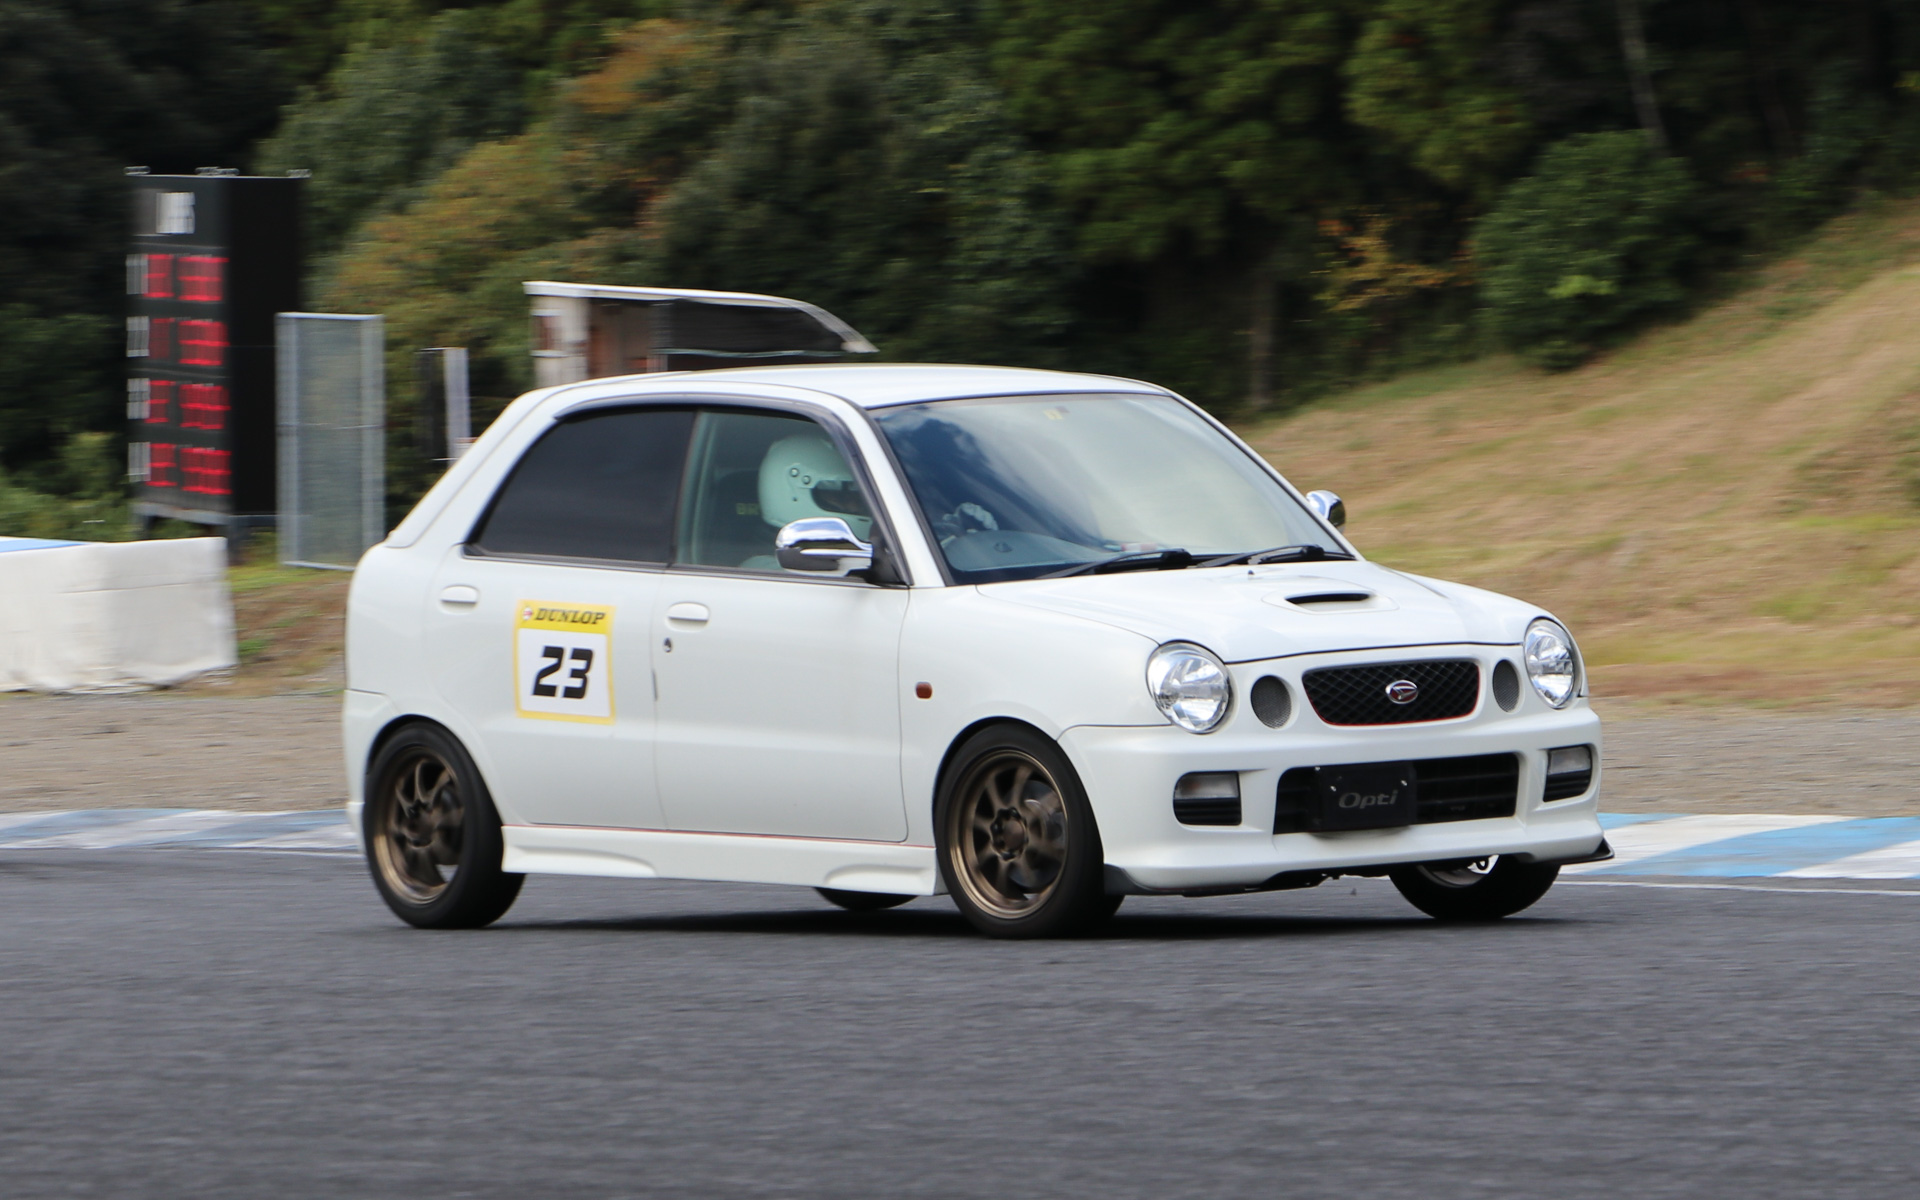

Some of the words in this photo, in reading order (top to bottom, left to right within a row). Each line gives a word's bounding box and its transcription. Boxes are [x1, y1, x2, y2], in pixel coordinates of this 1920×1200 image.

[535, 607, 606, 625] DUNLOP
[531, 645, 594, 699] 23
[1338, 789, 1399, 809] Opti
